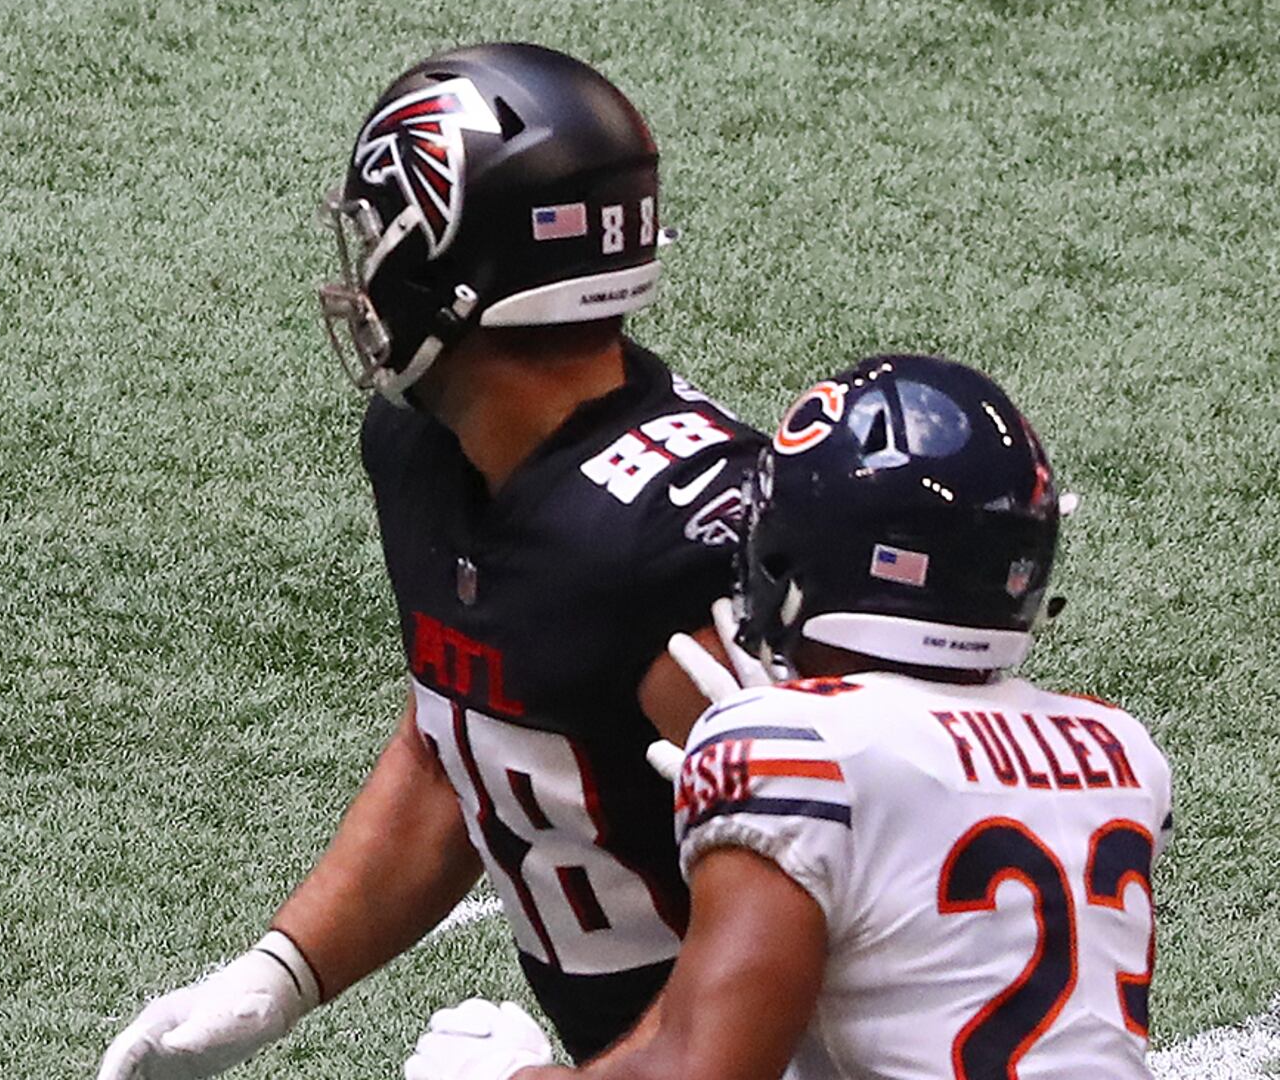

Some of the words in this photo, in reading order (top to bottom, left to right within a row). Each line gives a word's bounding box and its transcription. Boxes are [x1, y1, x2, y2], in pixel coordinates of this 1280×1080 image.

[601, 196, 654, 255] 88
[580, 411, 736, 505] 88
[411, 610, 526, 717] ATL
[929, 710, 1141, 790] FULLER
